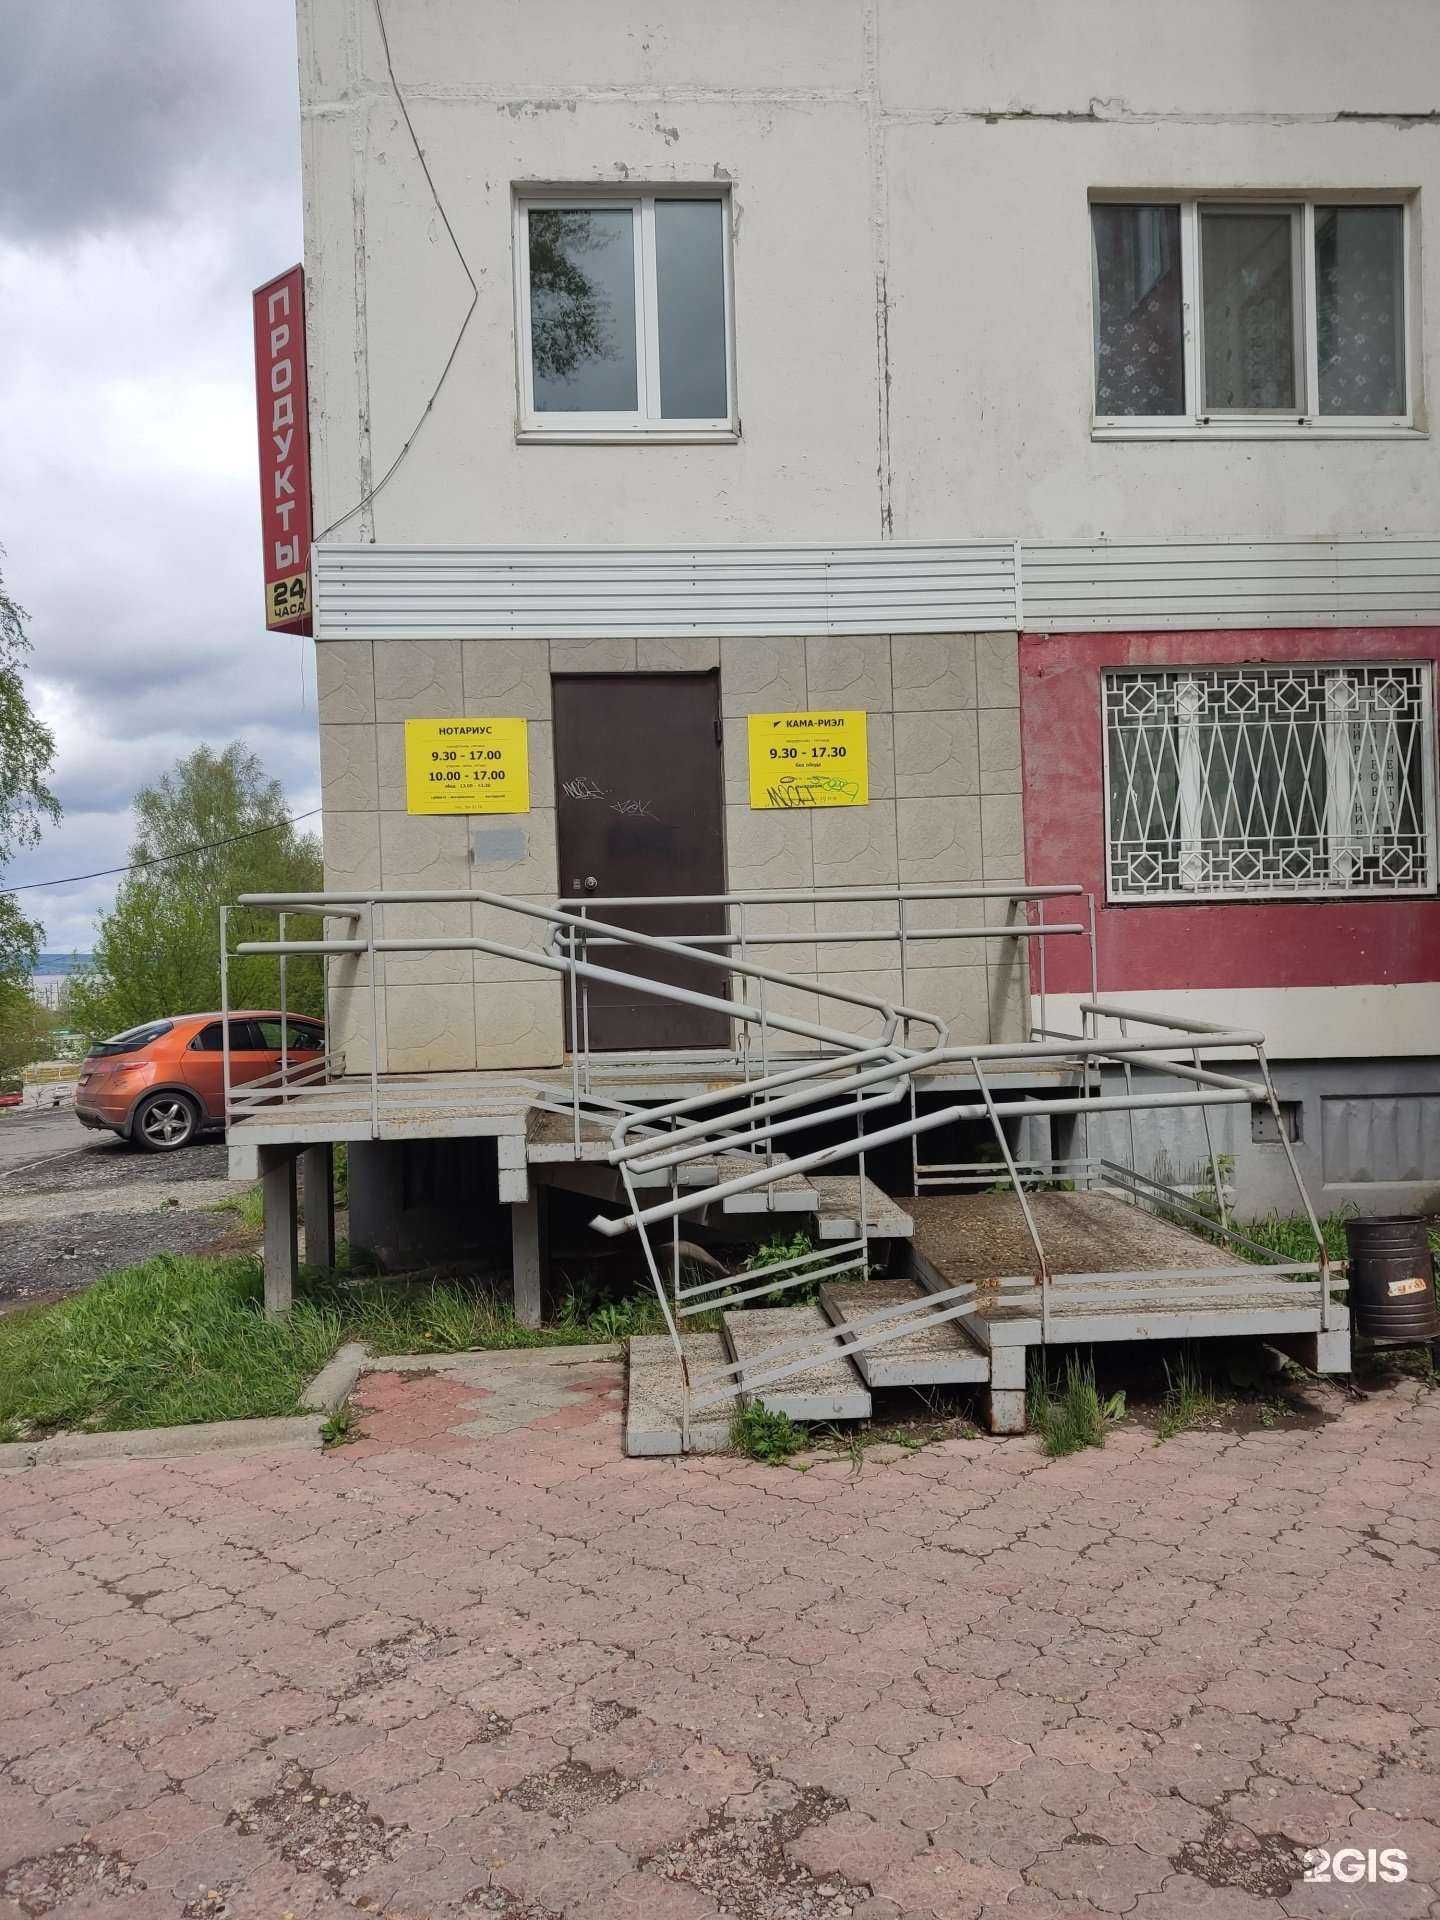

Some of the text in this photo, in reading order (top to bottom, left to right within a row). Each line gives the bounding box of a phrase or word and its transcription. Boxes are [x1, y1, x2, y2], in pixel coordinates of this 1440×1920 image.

[268, 286, 299, 570] ПРОДУКТЫ
[274, 578, 304, 606] 24
[275, 602, 305, 617] ЧАСА
[786, 718, 844, 728] КАМА-РИЭЛ
[439, 726, 492, 735] НОТАРИУС
[431, 751, 457, 761] 9.30
[469, 750, 502, 760] 17.00
[769, 748, 798, 759] 9.30
[811, 746, 847, 758] 17.30
[429, 771, 461, 782] 10.00
[473, 770, 505, 780] 17.00
